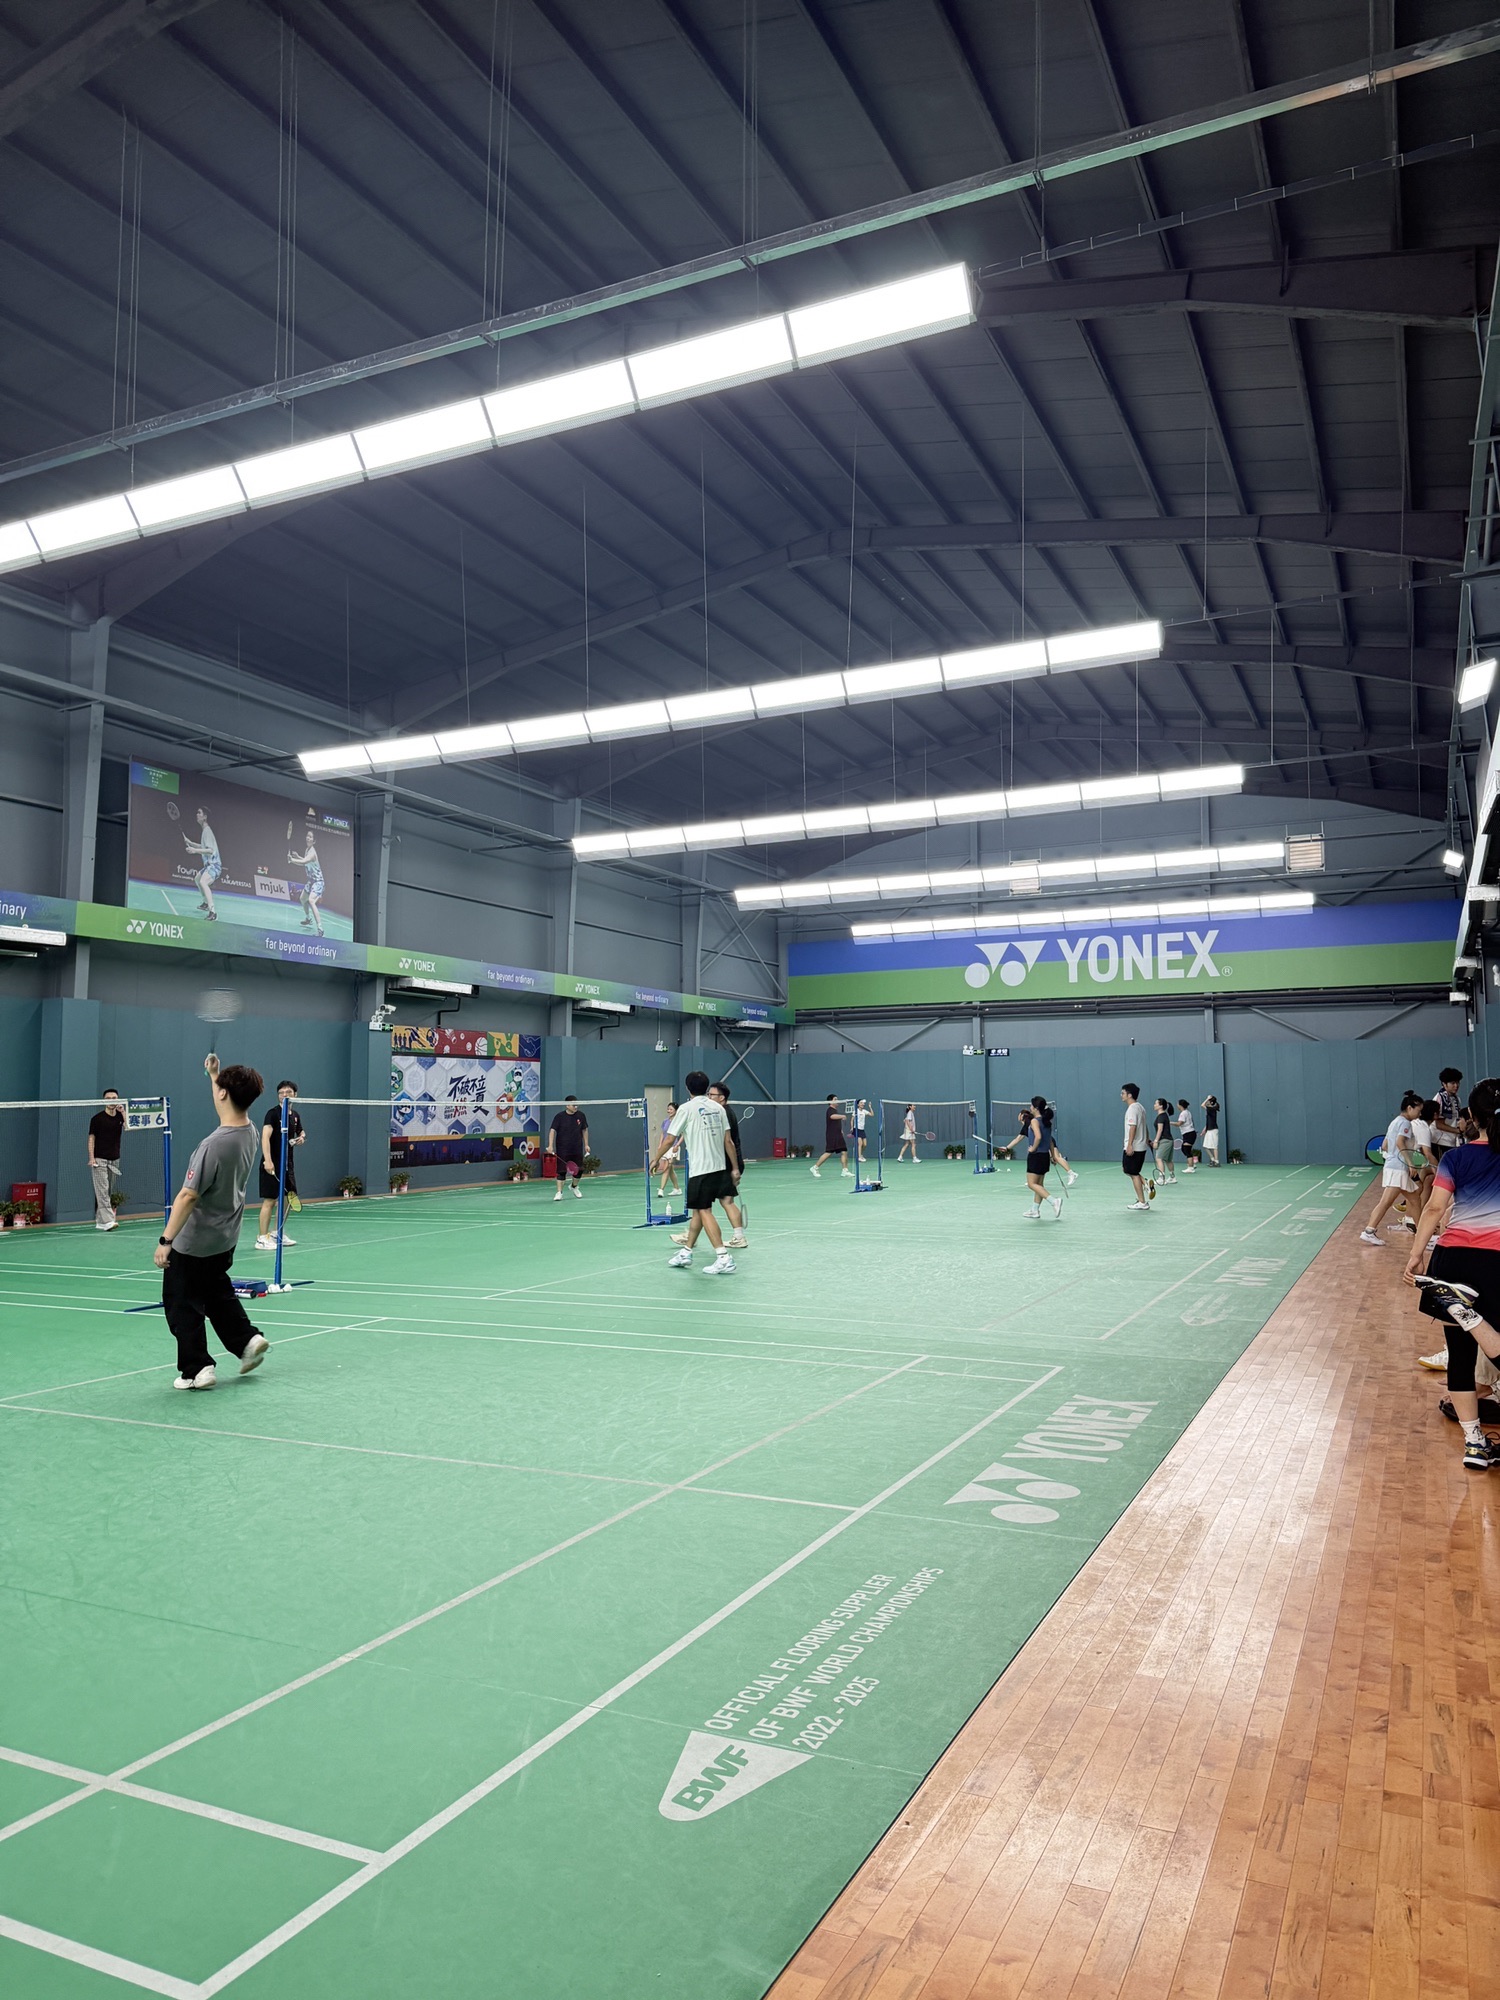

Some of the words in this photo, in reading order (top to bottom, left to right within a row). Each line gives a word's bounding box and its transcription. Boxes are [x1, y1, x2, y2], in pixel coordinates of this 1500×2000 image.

[260, 881, 285, 894] mjuk
[150, 921, 184, 939] YONEX
[265, 937, 277, 949] far
[279, 940, 305, 954] beyond
[308, 943, 337, 960] ordinary
[1057, 929, 1221, 983] YONEX
[413, 960, 436, 973] YONEX
[487, 970, 495, 979] far
[496, 971, 514, 983] beyond
[515, 974, 535, 986] ordinary
[584, 986, 600, 995] YONEX
[641, 993, 655, 1002] beyond
[655, 995, 669, 1005] ordinary
[129, 1115, 151, 1127] 赛事
[155, 1113, 165, 1125] 6
[1001, 1394, 1159, 1463] YONEX
[704, 1673, 789, 1731] OFFICIAL
[770, 1619, 845, 1671] FLOORING
[830, 1574, 896, 1619] SUPPLIER
[748, 1717, 785, 1740] OF
[769, 1686, 818, 1719] BWF
[802, 1644, 864, 1685] WORLD
[849, 1567, 944, 1643] CHAMPIONSHIPS
[792, 1715, 844, 1750] 2022
[833, 1676, 880, 1707] 2025
[671, 1744, 749, 1812] BWF
